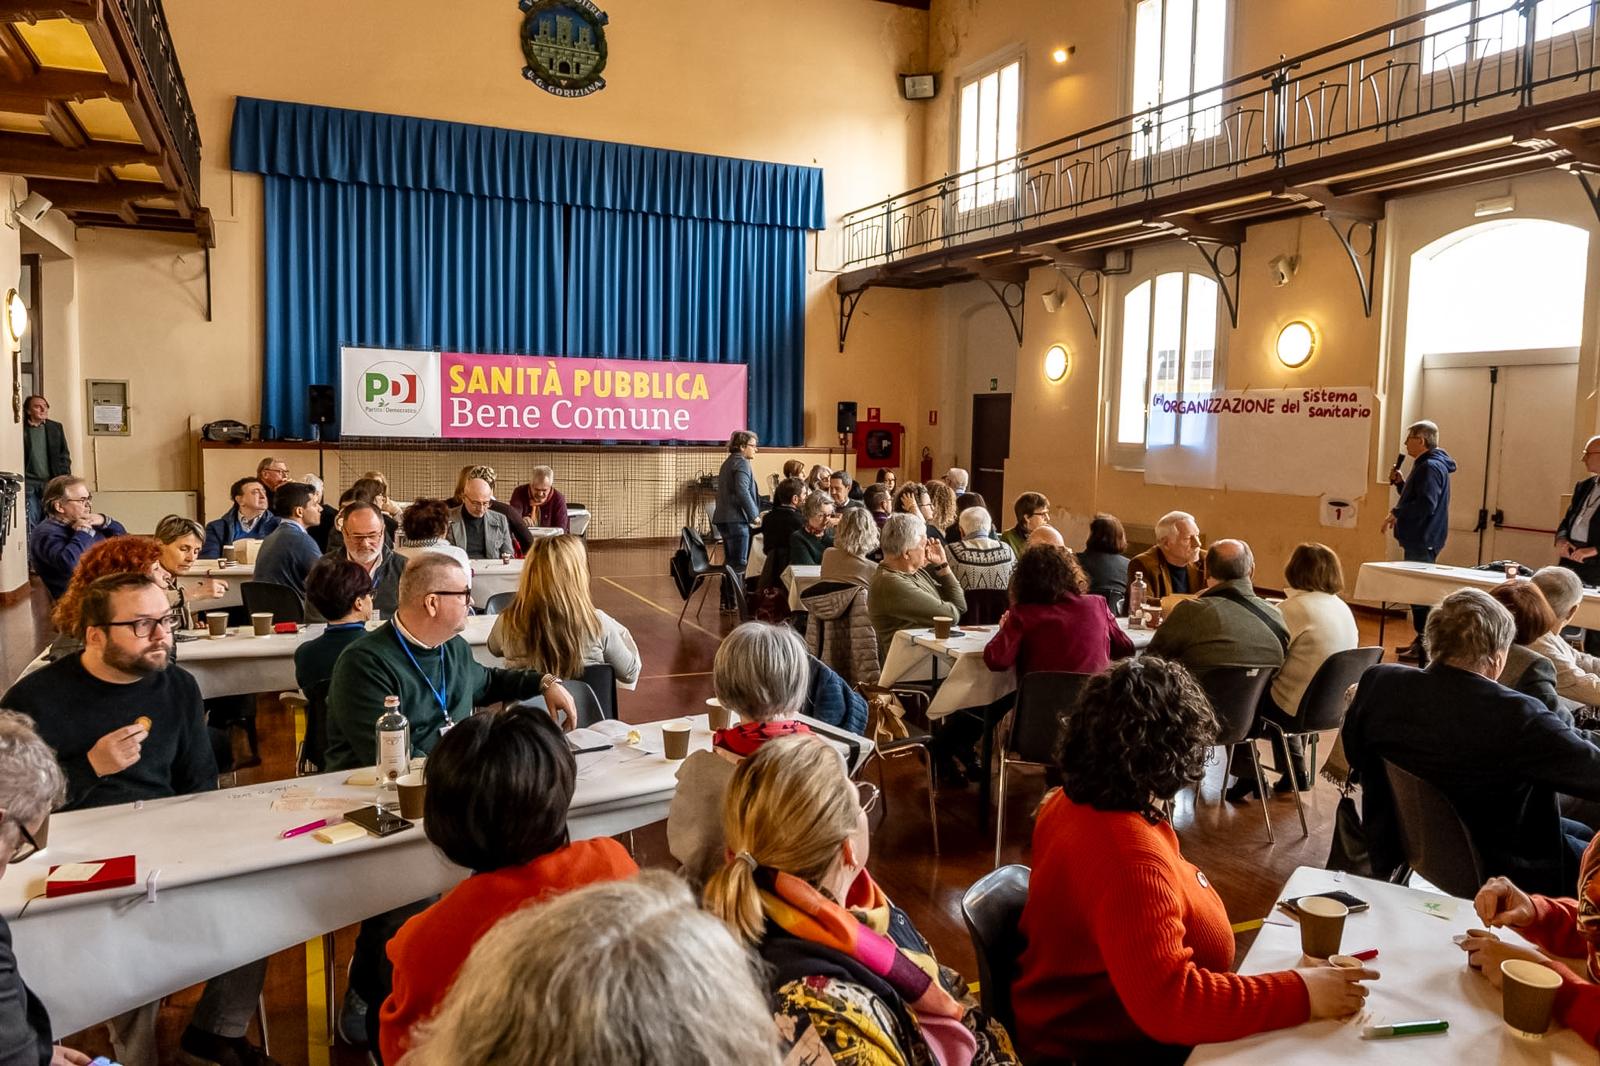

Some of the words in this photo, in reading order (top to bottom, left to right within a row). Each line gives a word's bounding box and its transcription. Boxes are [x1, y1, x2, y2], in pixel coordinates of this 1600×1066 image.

[547, 80, 602, 97] GORIZIANA
[365, 372, 417, 404] PD
[449, 360, 563, 396] SANITÀ
[574, 369, 710, 400] PUBBLICA
[449, 397, 540, 428] Bene
[551, 400, 690, 430] Comune
[1281, 398, 1300, 414] del
[1303, 388, 1358, 403] sistema
[1308, 404, 1371, 418] sanitario
[1335, 508, 1342, 521] 1
